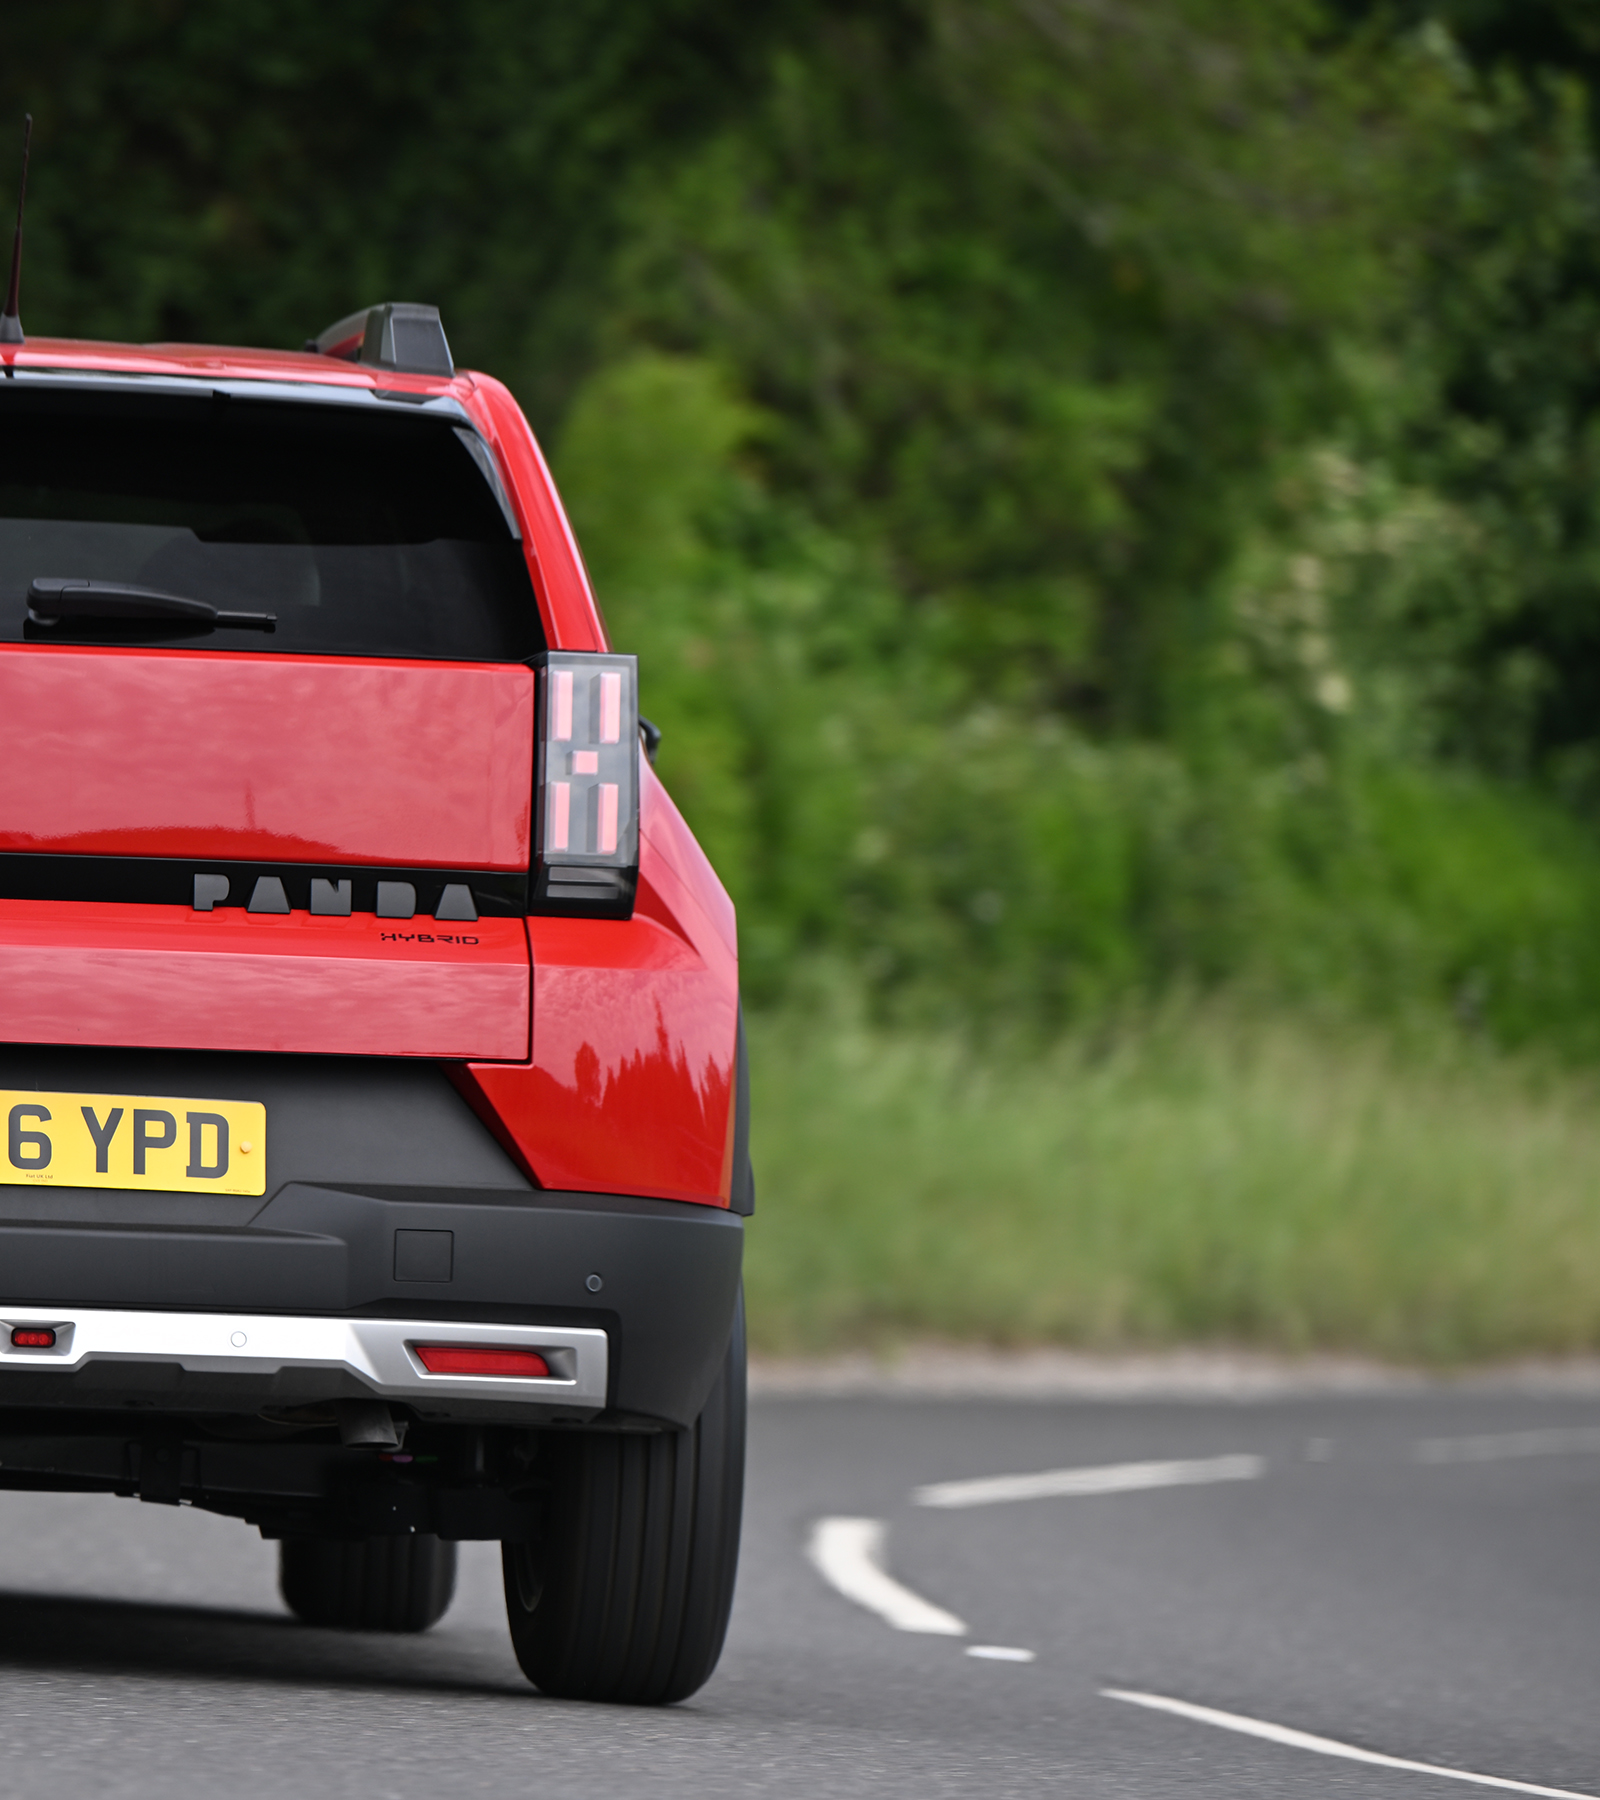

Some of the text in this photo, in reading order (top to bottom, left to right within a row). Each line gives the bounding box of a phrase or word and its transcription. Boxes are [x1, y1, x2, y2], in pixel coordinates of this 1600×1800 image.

[192, 873, 479, 921] PANDA
[380, 932, 480, 945] HYBRID
[80, 1106, 230, 1180] YPD
